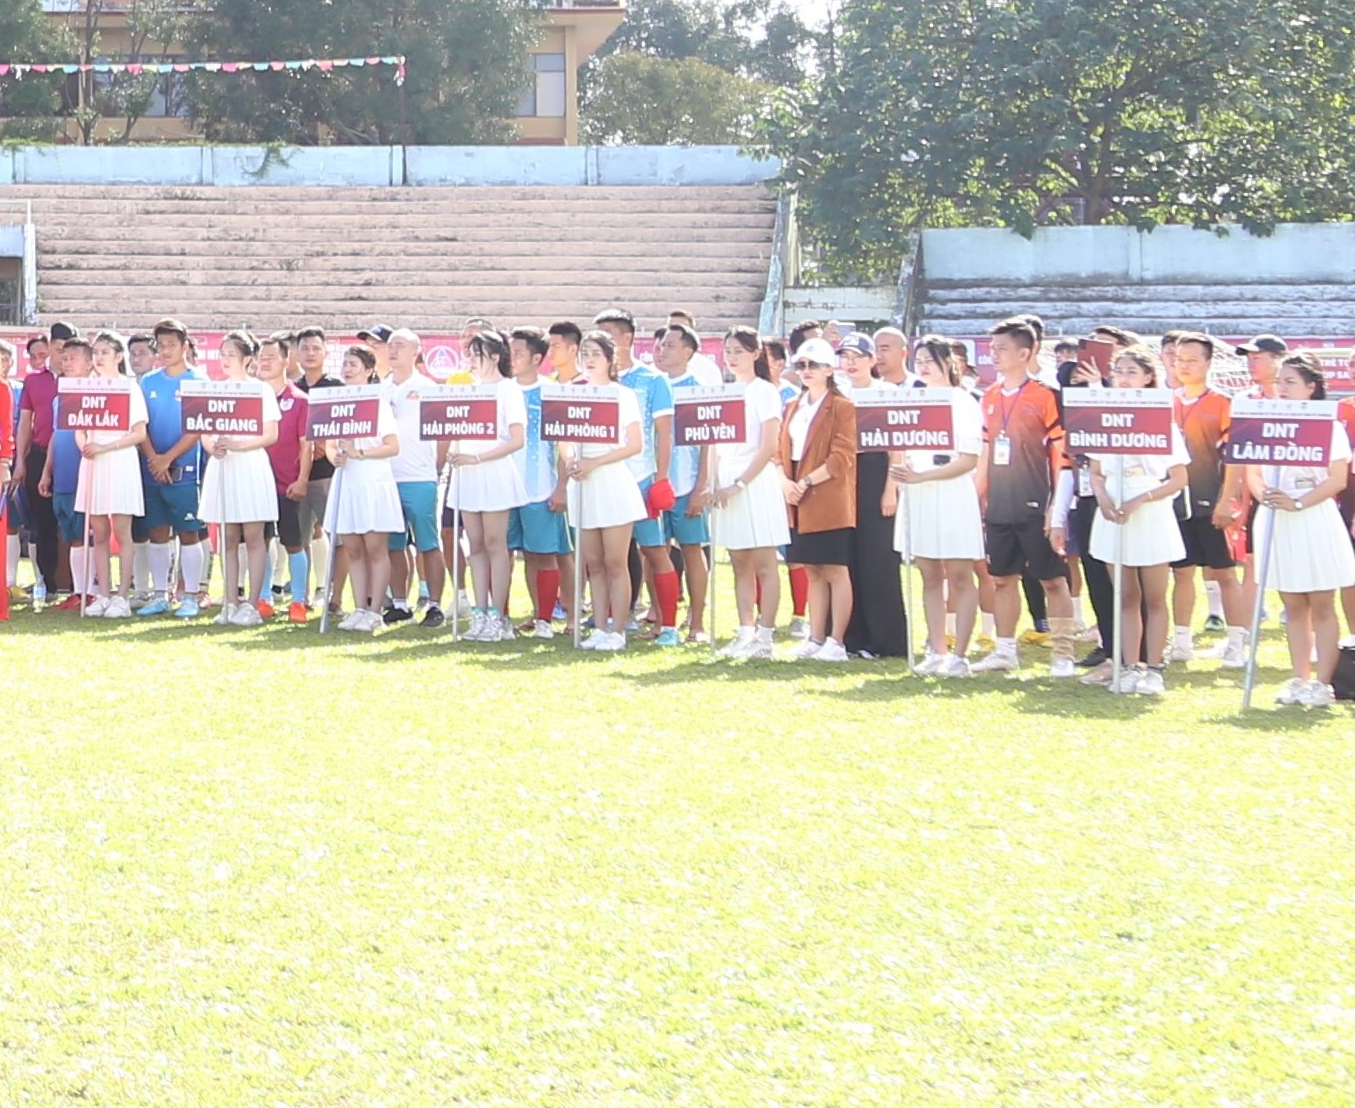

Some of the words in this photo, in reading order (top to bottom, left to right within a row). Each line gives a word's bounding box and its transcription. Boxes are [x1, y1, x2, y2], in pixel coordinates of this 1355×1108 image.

[82, 396, 106, 408] DNT
[208, 400, 236, 412] DNT
[331, 404, 355, 418] DNT
[446, 406, 470, 418] DNT
[568, 407, 591, 419] DNT
[697, 406, 721, 420] DNT
[888, 410, 920, 424] DNT
[216, 418, 257, 432] GIANG
[1101, 413, 1134, 427] DNT
[313, 420, 340, 437] THÁI
[342, 419, 371, 435] BÌNH
[423, 420, 442, 435] HẢI
[444, 421, 484, 435] PHÒNG
[487, 423, 494, 434] 2
[545, 421, 564, 436] HẢI
[567, 423, 607, 438] PHÒNG
[610, 426, 615, 438] 1
[685, 424, 709, 441] PHÚ
[711, 423, 736, 439] YÊN
[1262, 423, 1299, 438] DNT
[861, 428, 889, 446] HẢI
[892, 430, 949, 446] DƯƠNG
[1070, 430, 1108, 447] BÌNH
[1111, 433, 1167, 448] DƯƠNG
[1232, 441, 1269, 460] LÂM
[1273, 441, 1322, 461] ĐỒNG
